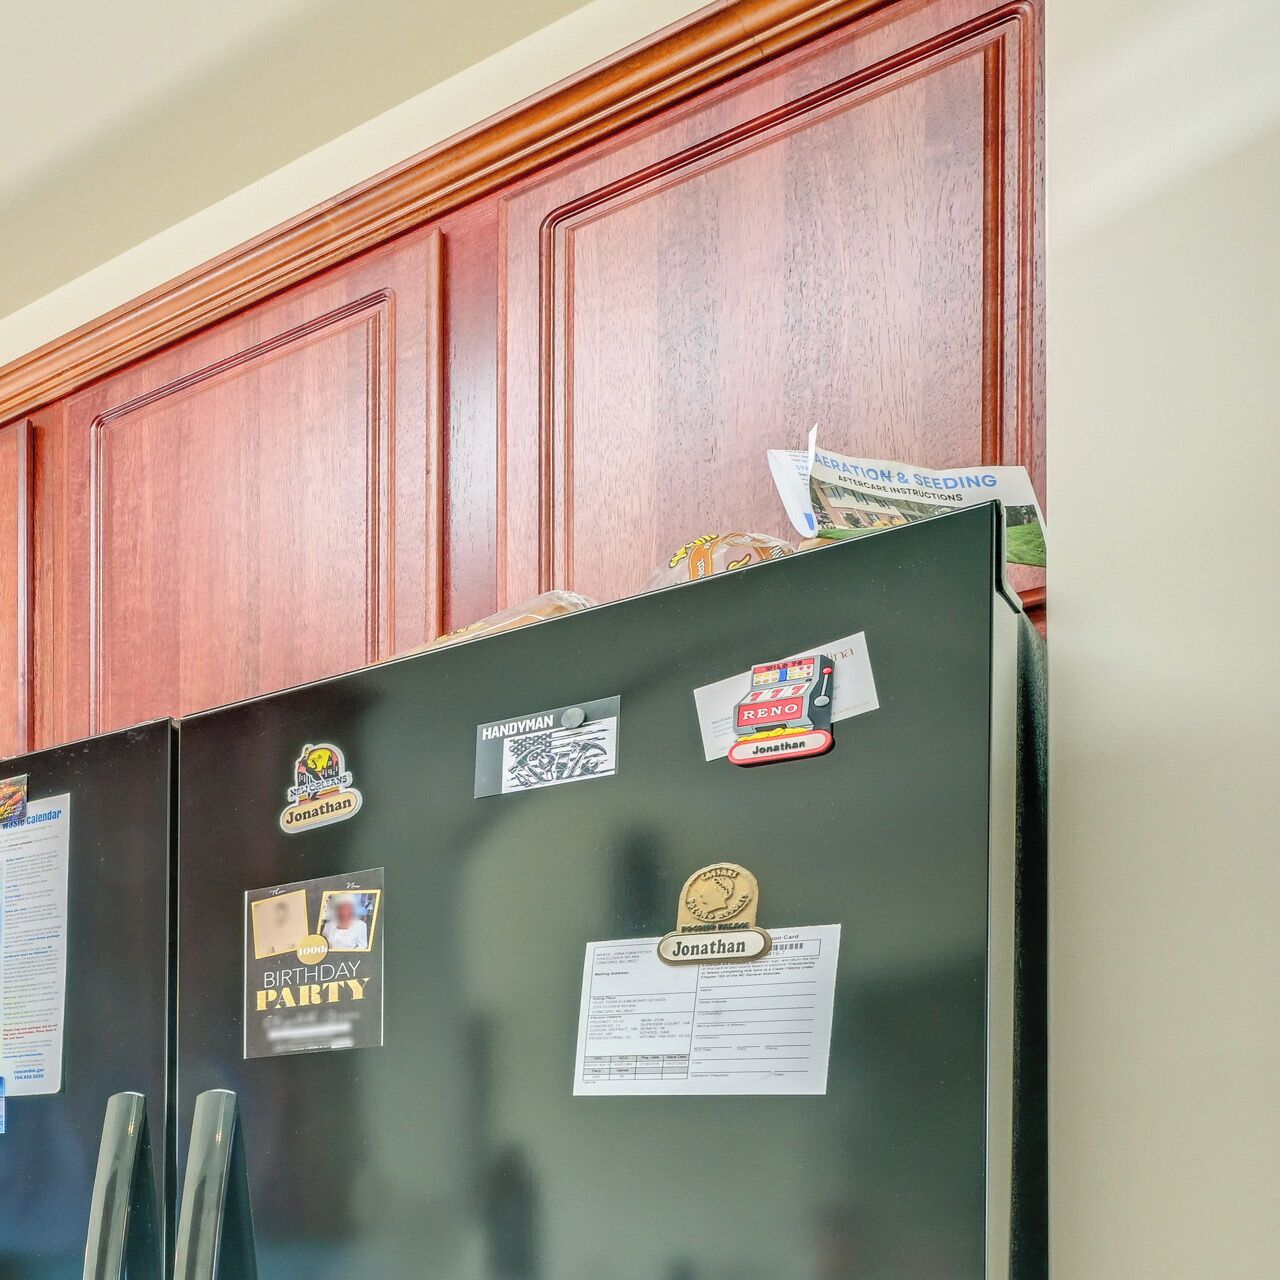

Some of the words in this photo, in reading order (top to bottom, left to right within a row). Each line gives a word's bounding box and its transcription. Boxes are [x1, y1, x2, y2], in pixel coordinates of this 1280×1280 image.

[814, 452, 894, 484] AERATION
[896, 472, 909, 484] &
[913, 473, 997, 490] SEEDING
[838, 475, 889, 493] AFTERCARE
[890, 487, 963, 502] INSTRUCTIONS
[743, 703, 799, 721] RENO
[482, 714, 554, 740] HANDYMAN
[752, 740, 806, 755] Jonathan
[290, 785, 308, 797] NEW
[308, 775, 348, 791] ORLEANS
[286, 798, 352, 825] Jonathan
[701, 868, 739, 881] CAESARS
[672, 939, 746, 957] Jonathan
[263, 960, 361, 988] BIRTHDAY
[255, 977, 371, 1012] PARTY
